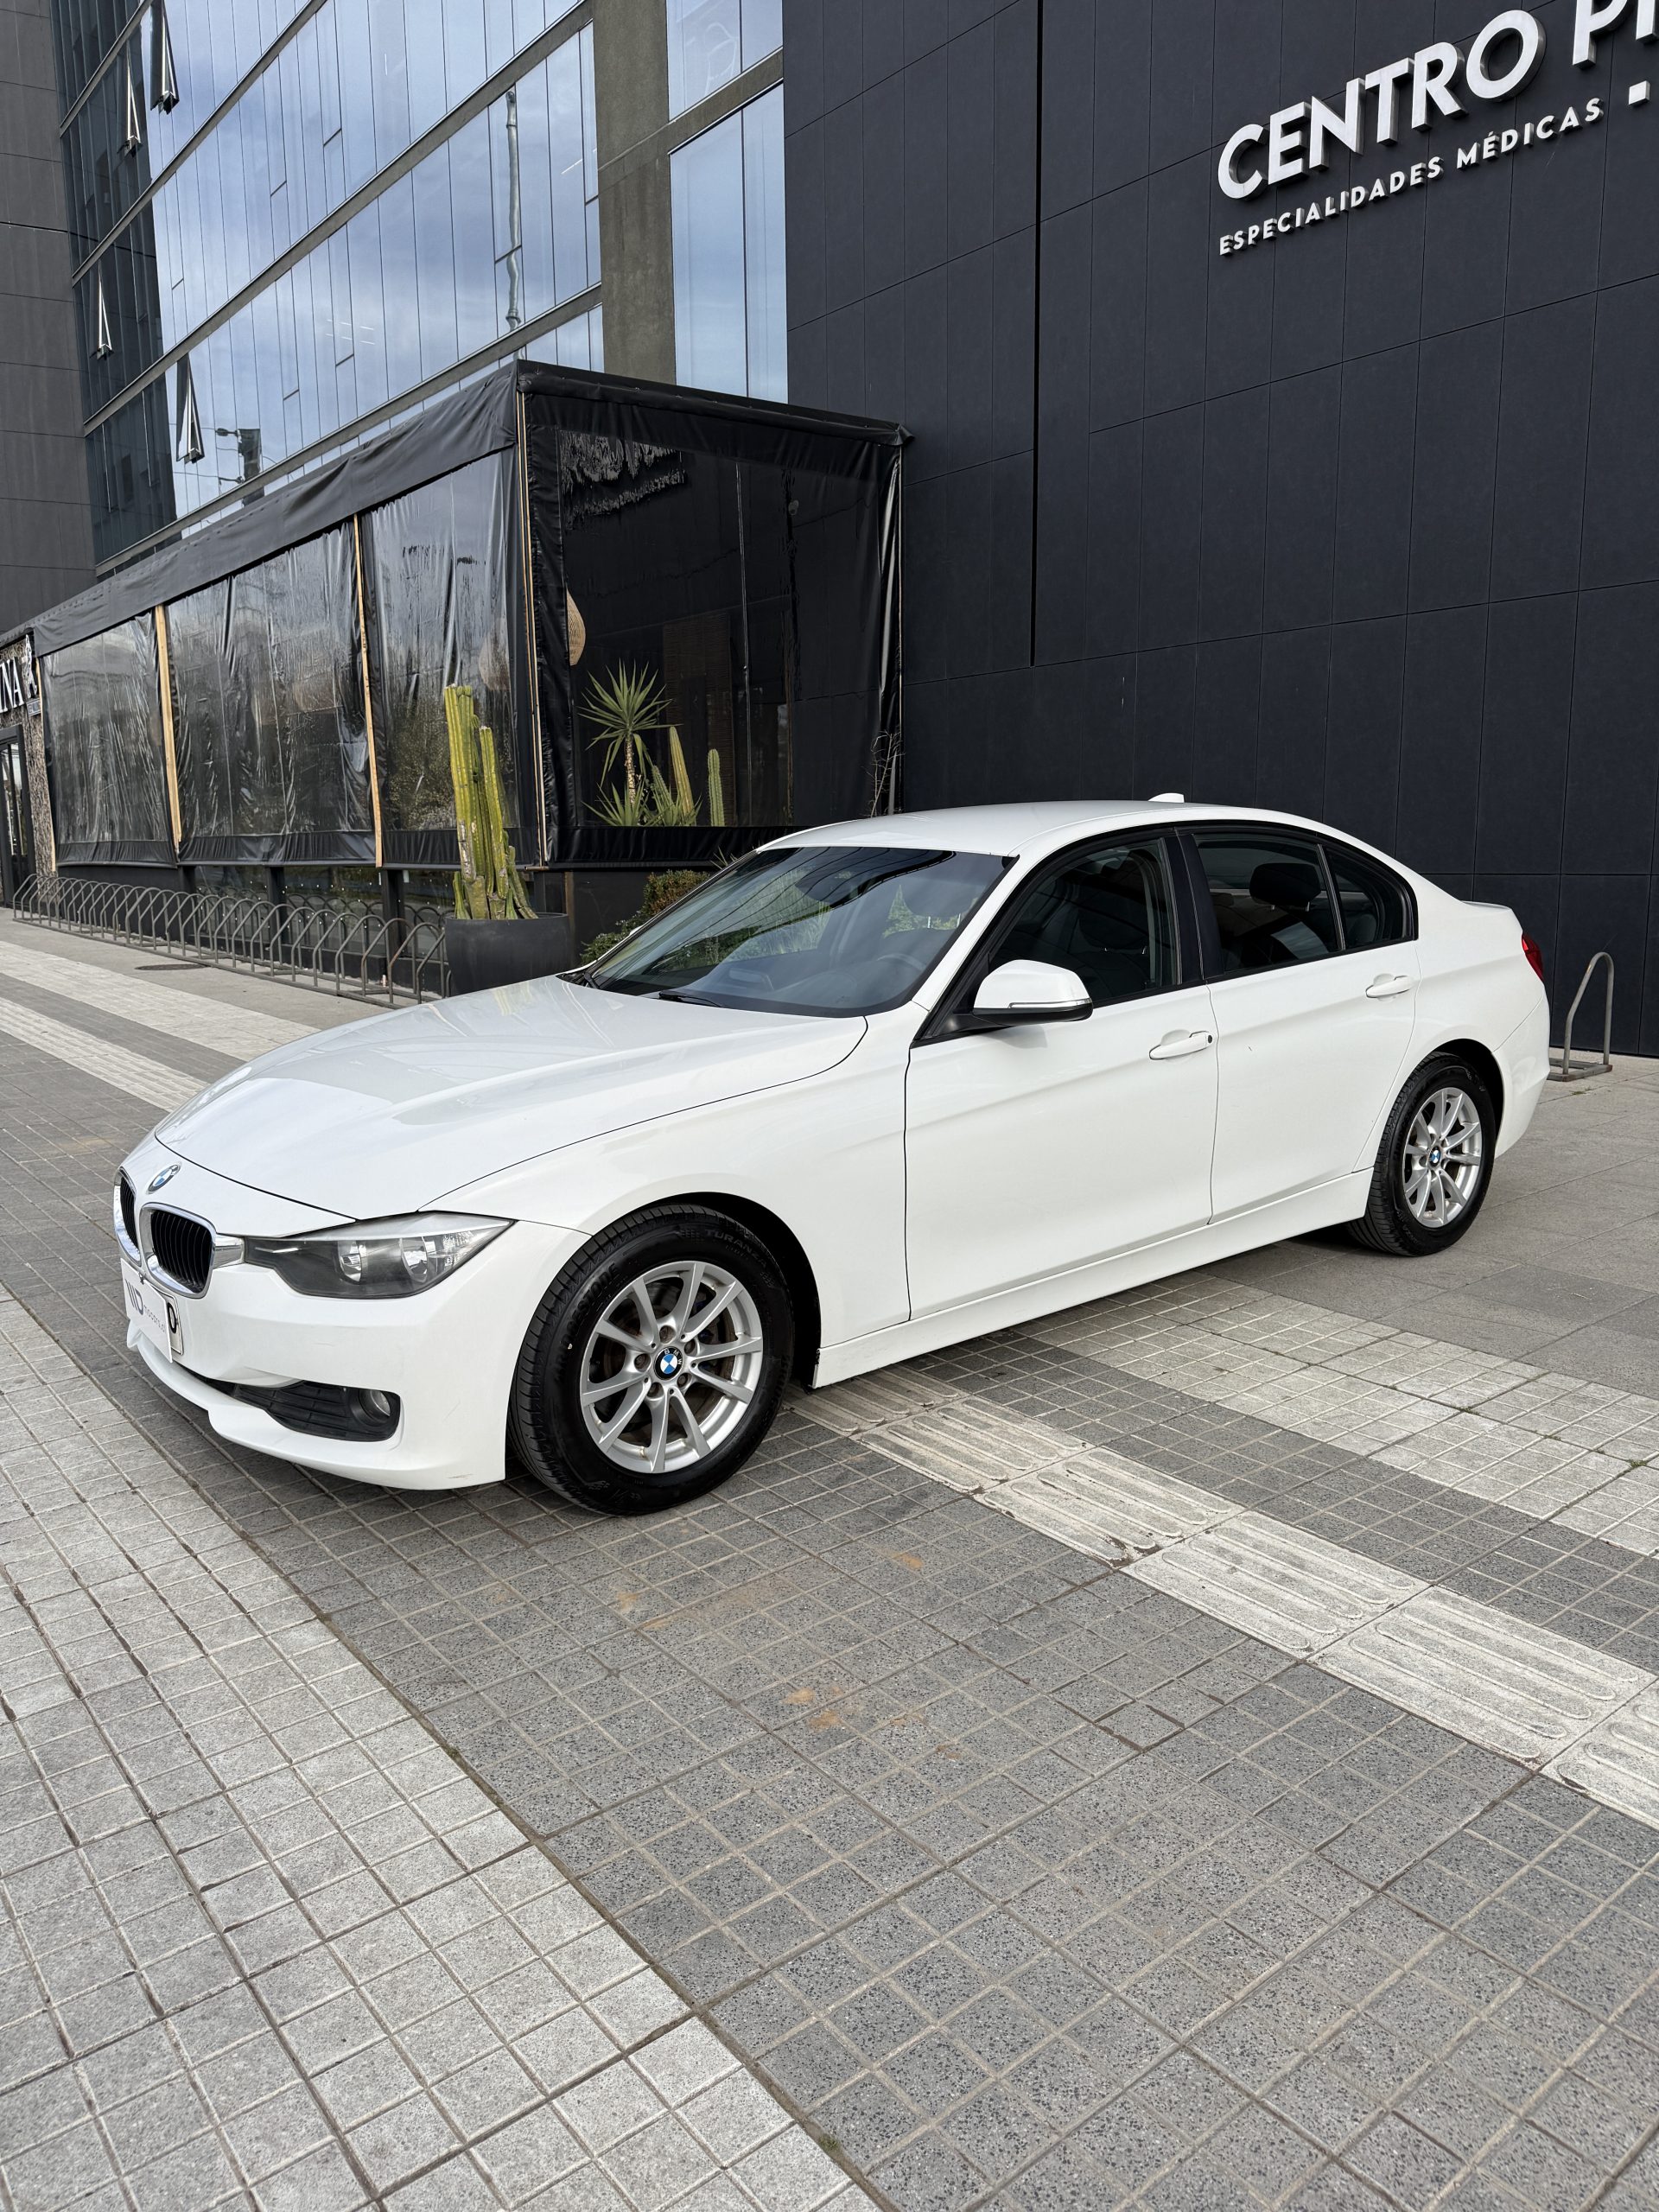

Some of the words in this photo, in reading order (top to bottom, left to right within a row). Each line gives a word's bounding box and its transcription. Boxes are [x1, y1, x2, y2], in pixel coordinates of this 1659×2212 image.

[1218, 10, 1546, 199] CENTRO
[1219, 156, 1444, 257] ESPECIALIDADES
[1456, 97, 1605, 170] MÉDICAS
[664, 1347, 683, 1365] BMW
